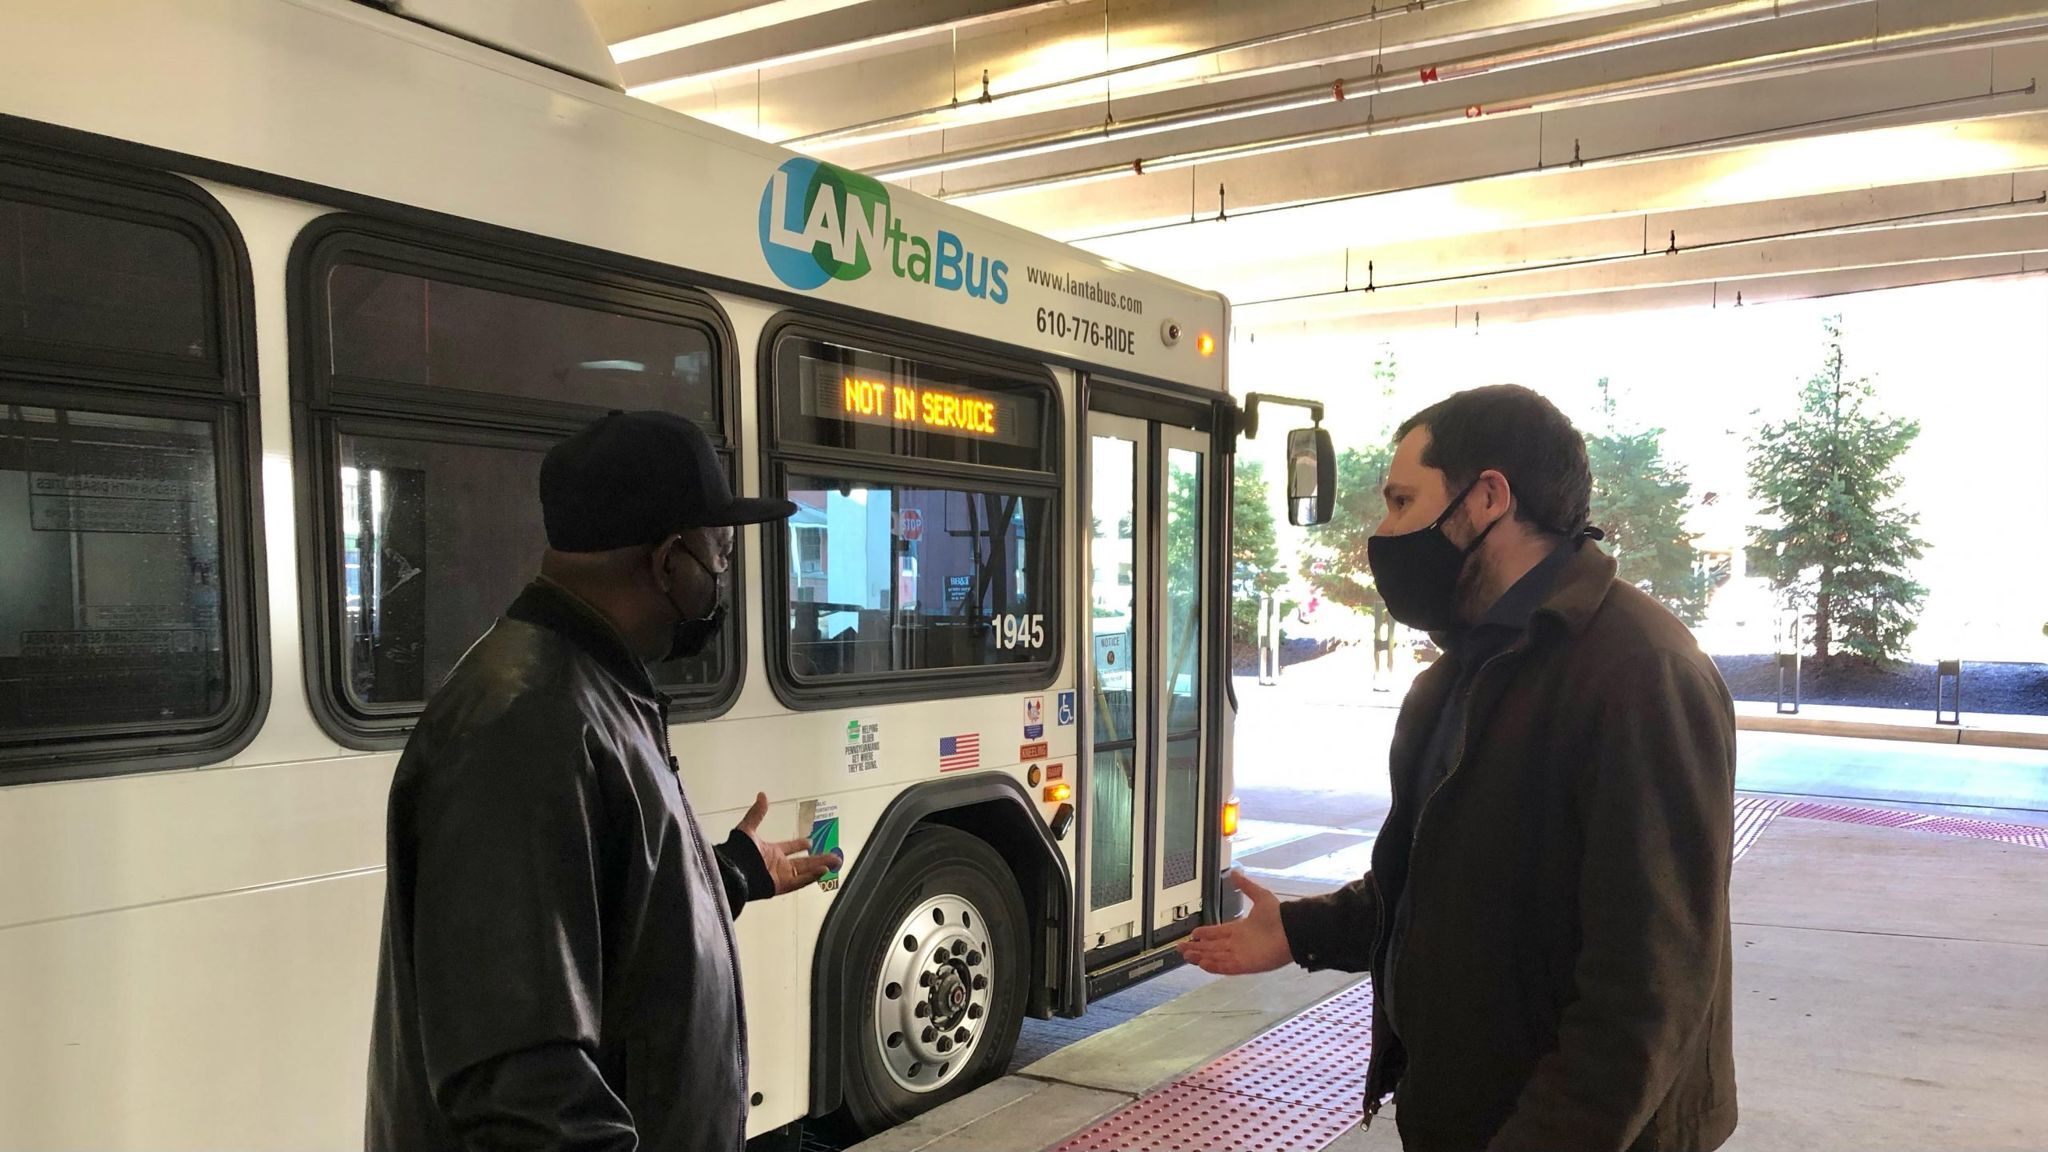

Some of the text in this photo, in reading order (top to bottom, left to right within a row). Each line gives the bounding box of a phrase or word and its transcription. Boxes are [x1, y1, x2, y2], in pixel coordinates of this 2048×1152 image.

[769, 169, 1009, 305] LANtaBus
[1027, 266, 1143, 315] www.lantabus.com
[1037, 306, 1136, 355] 610-776-RIDE
[844, 377, 995, 434] NOT IN SERVICE
[902, 518, 922, 531] STOP
[991, 613, 1045, 650] 1945
[1101, 637, 1120, 647] NOTICE
